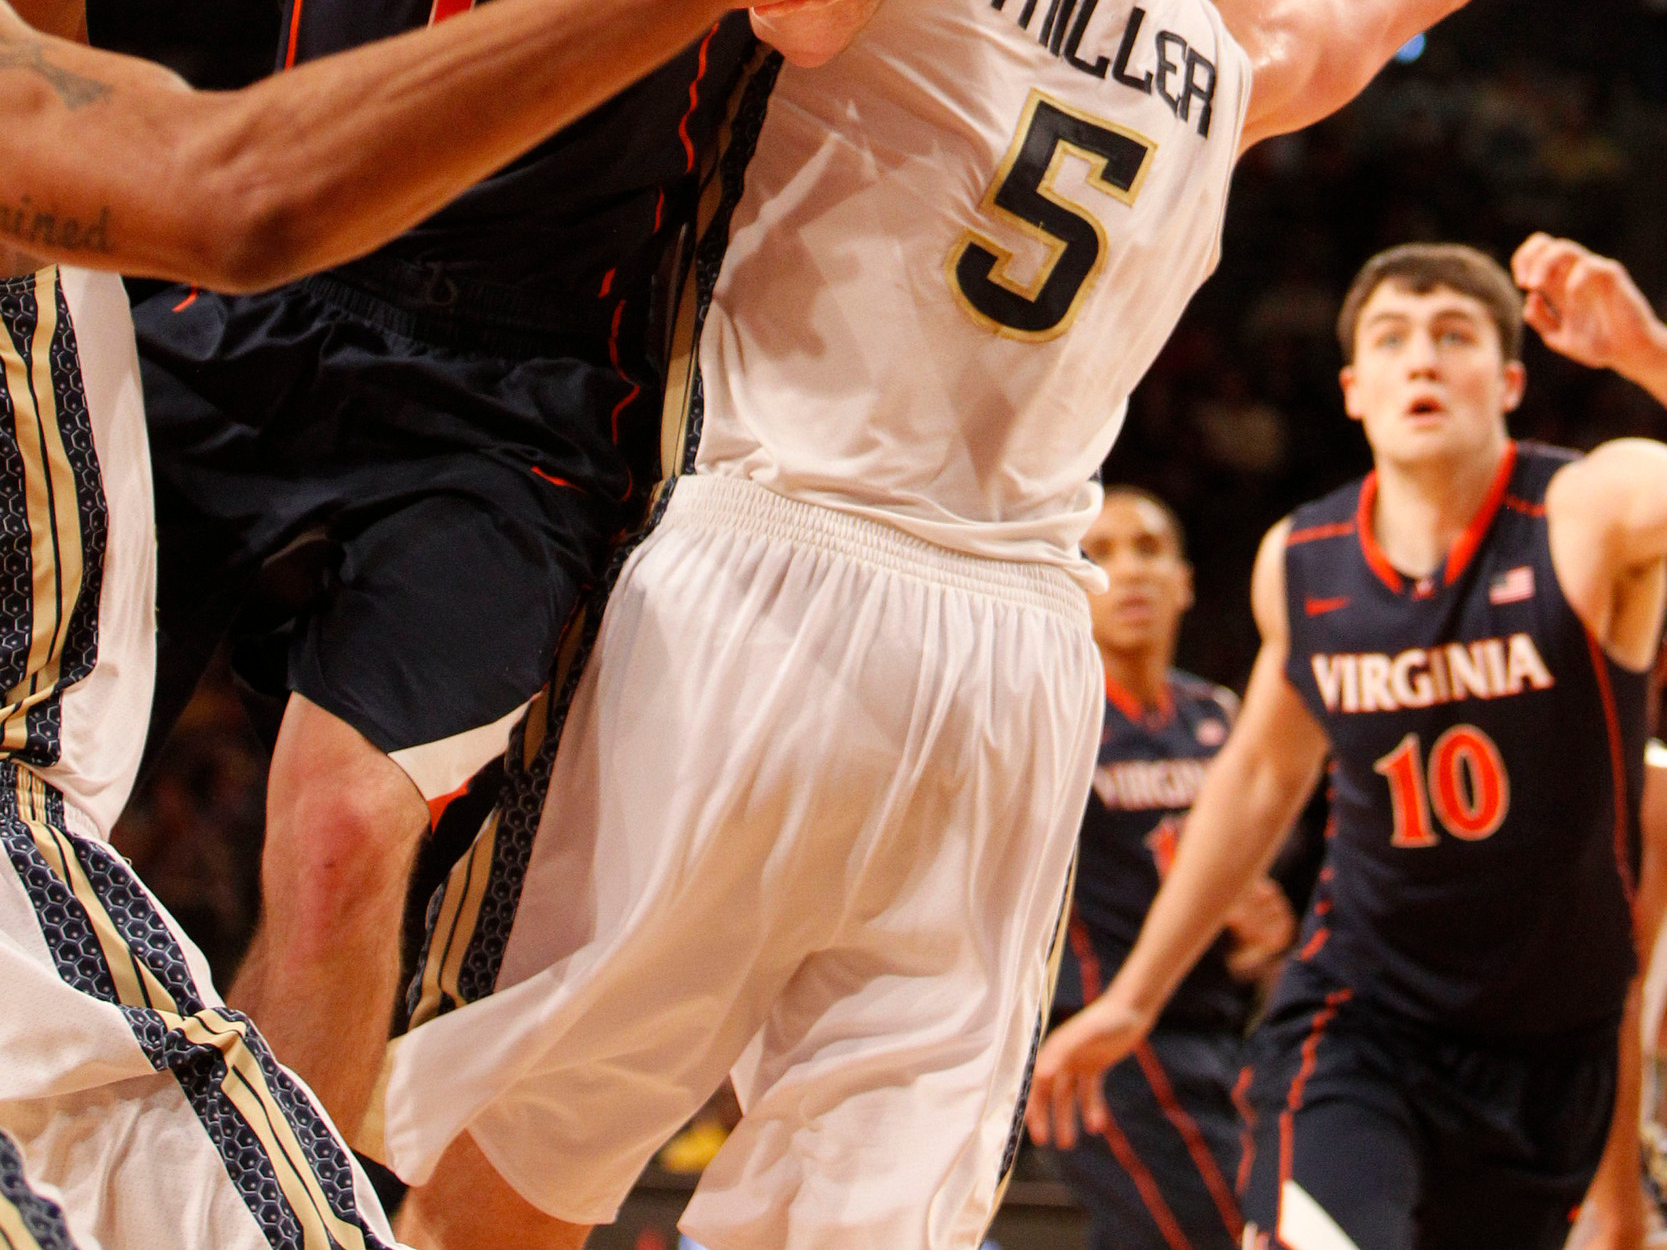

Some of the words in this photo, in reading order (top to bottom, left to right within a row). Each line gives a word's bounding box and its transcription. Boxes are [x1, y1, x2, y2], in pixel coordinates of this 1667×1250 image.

[945, 87, 1159, 344] 5
[1311, 632, 1555, 715] VIRGINIA
[1373, 723, 1511, 849] 10
